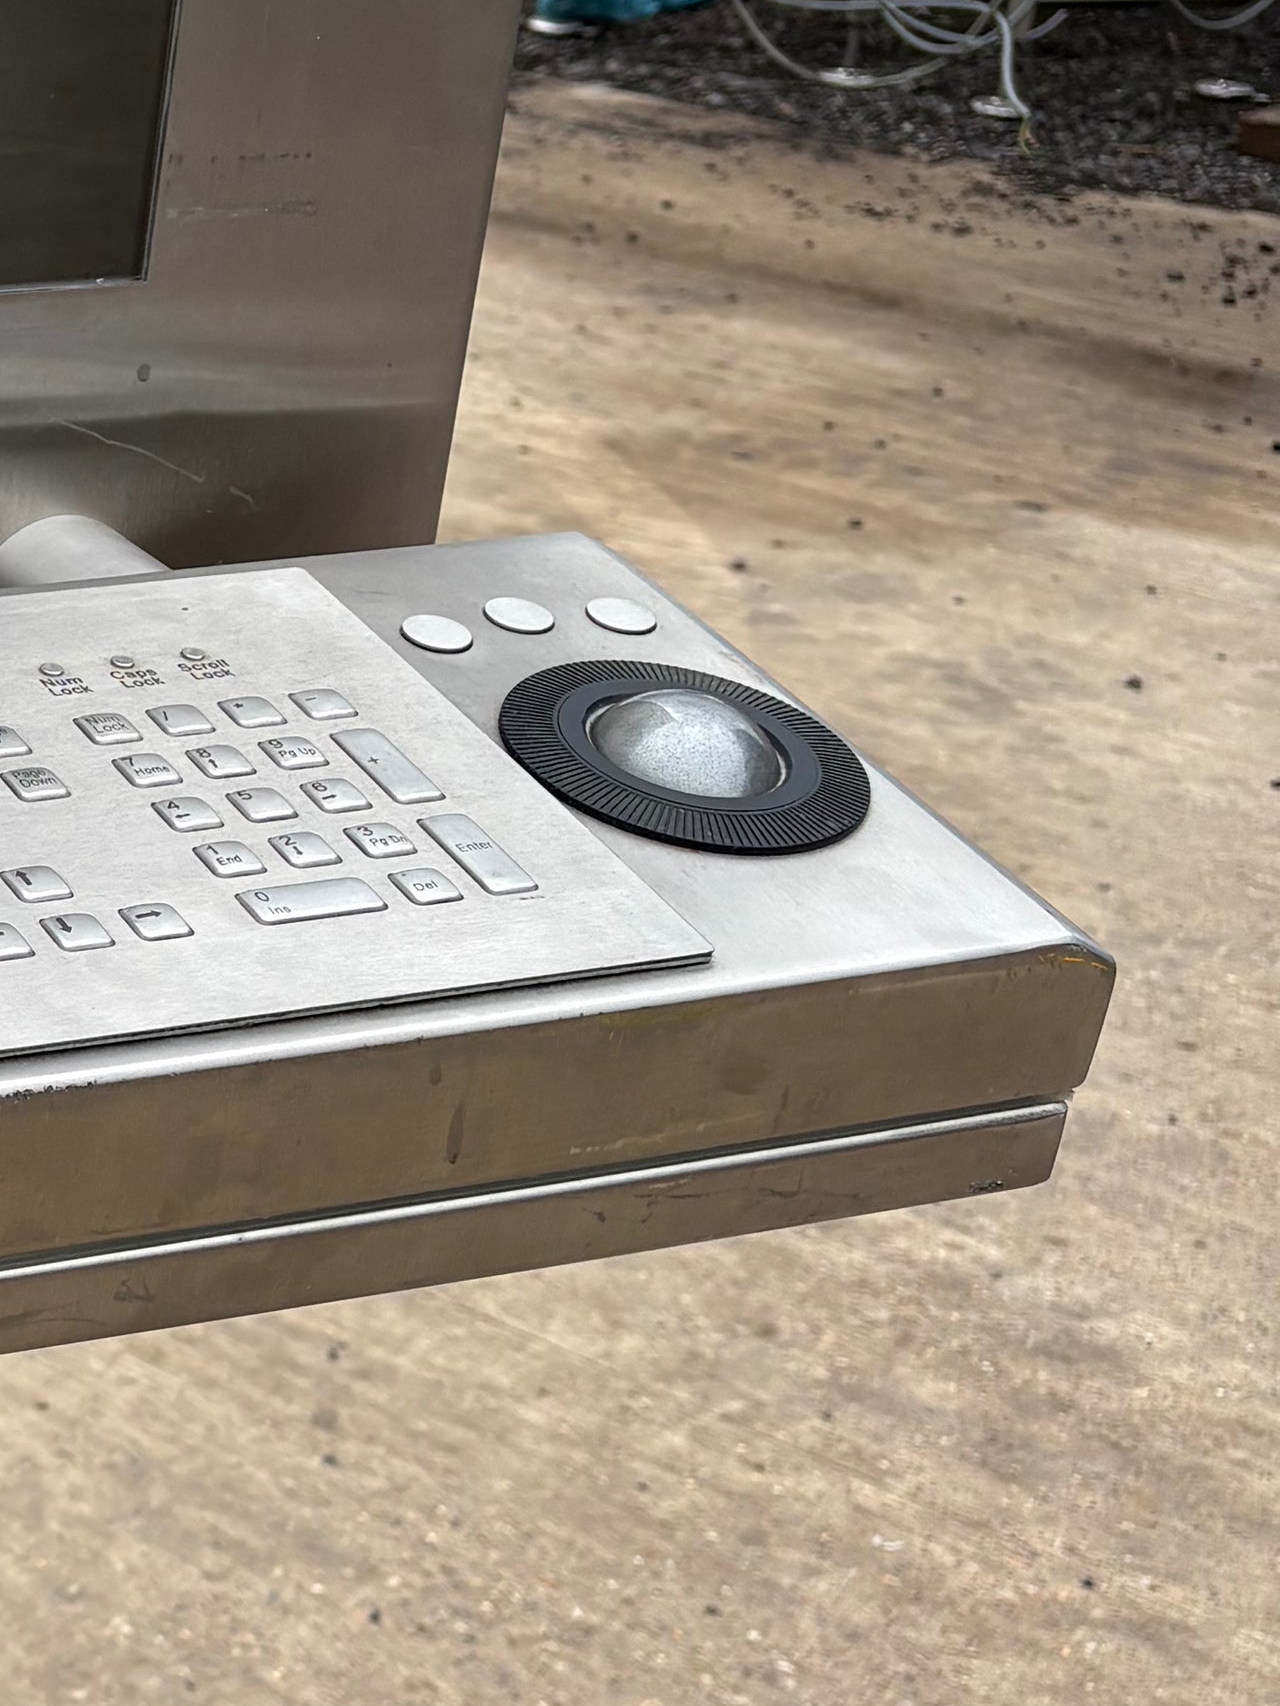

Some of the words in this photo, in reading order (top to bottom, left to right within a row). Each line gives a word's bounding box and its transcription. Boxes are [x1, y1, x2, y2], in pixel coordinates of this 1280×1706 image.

[178, 659, 230, 672] Scroll
[110, 668, 158, 681] Caps
[190, 669, 235, 680] Lock
[40, 676, 83, 687] Num
[120, 678, 165, 689] Lock
[48, 686, 93, 696] Lock
[84, 715, 120, 725] Num
[93, 722, 129, 733] Lock
[268, 739, 282, 748] 9
[195, 748, 211, 757] 8
[278, 749, 297, 758] Pg
[300, 747, 316, 756] Up
[120, 757, 135, 766] 7
[14, 769, 45, 779] Page
[133, 765, 169, 776] Home
[19, 777, 58, 788] Down
[312, 782, 327, 791] 6
[237, 792, 252, 800] 5
[167, 801, 181, 810] 4
[357, 826, 373, 835] 3
[278, 835, 297, 845] 2
[369, 838, 387, 846] Pg
[390, 835, 406, 844] Dn
[206, 845, 218, 854] 1
[455, 842, 492, 853] Enter
[216, 855, 241, 865] End
[412, 881, 438, 891] Del
[254, 892, 269, 902] 0
[268, 905, 291, 914] Ins
